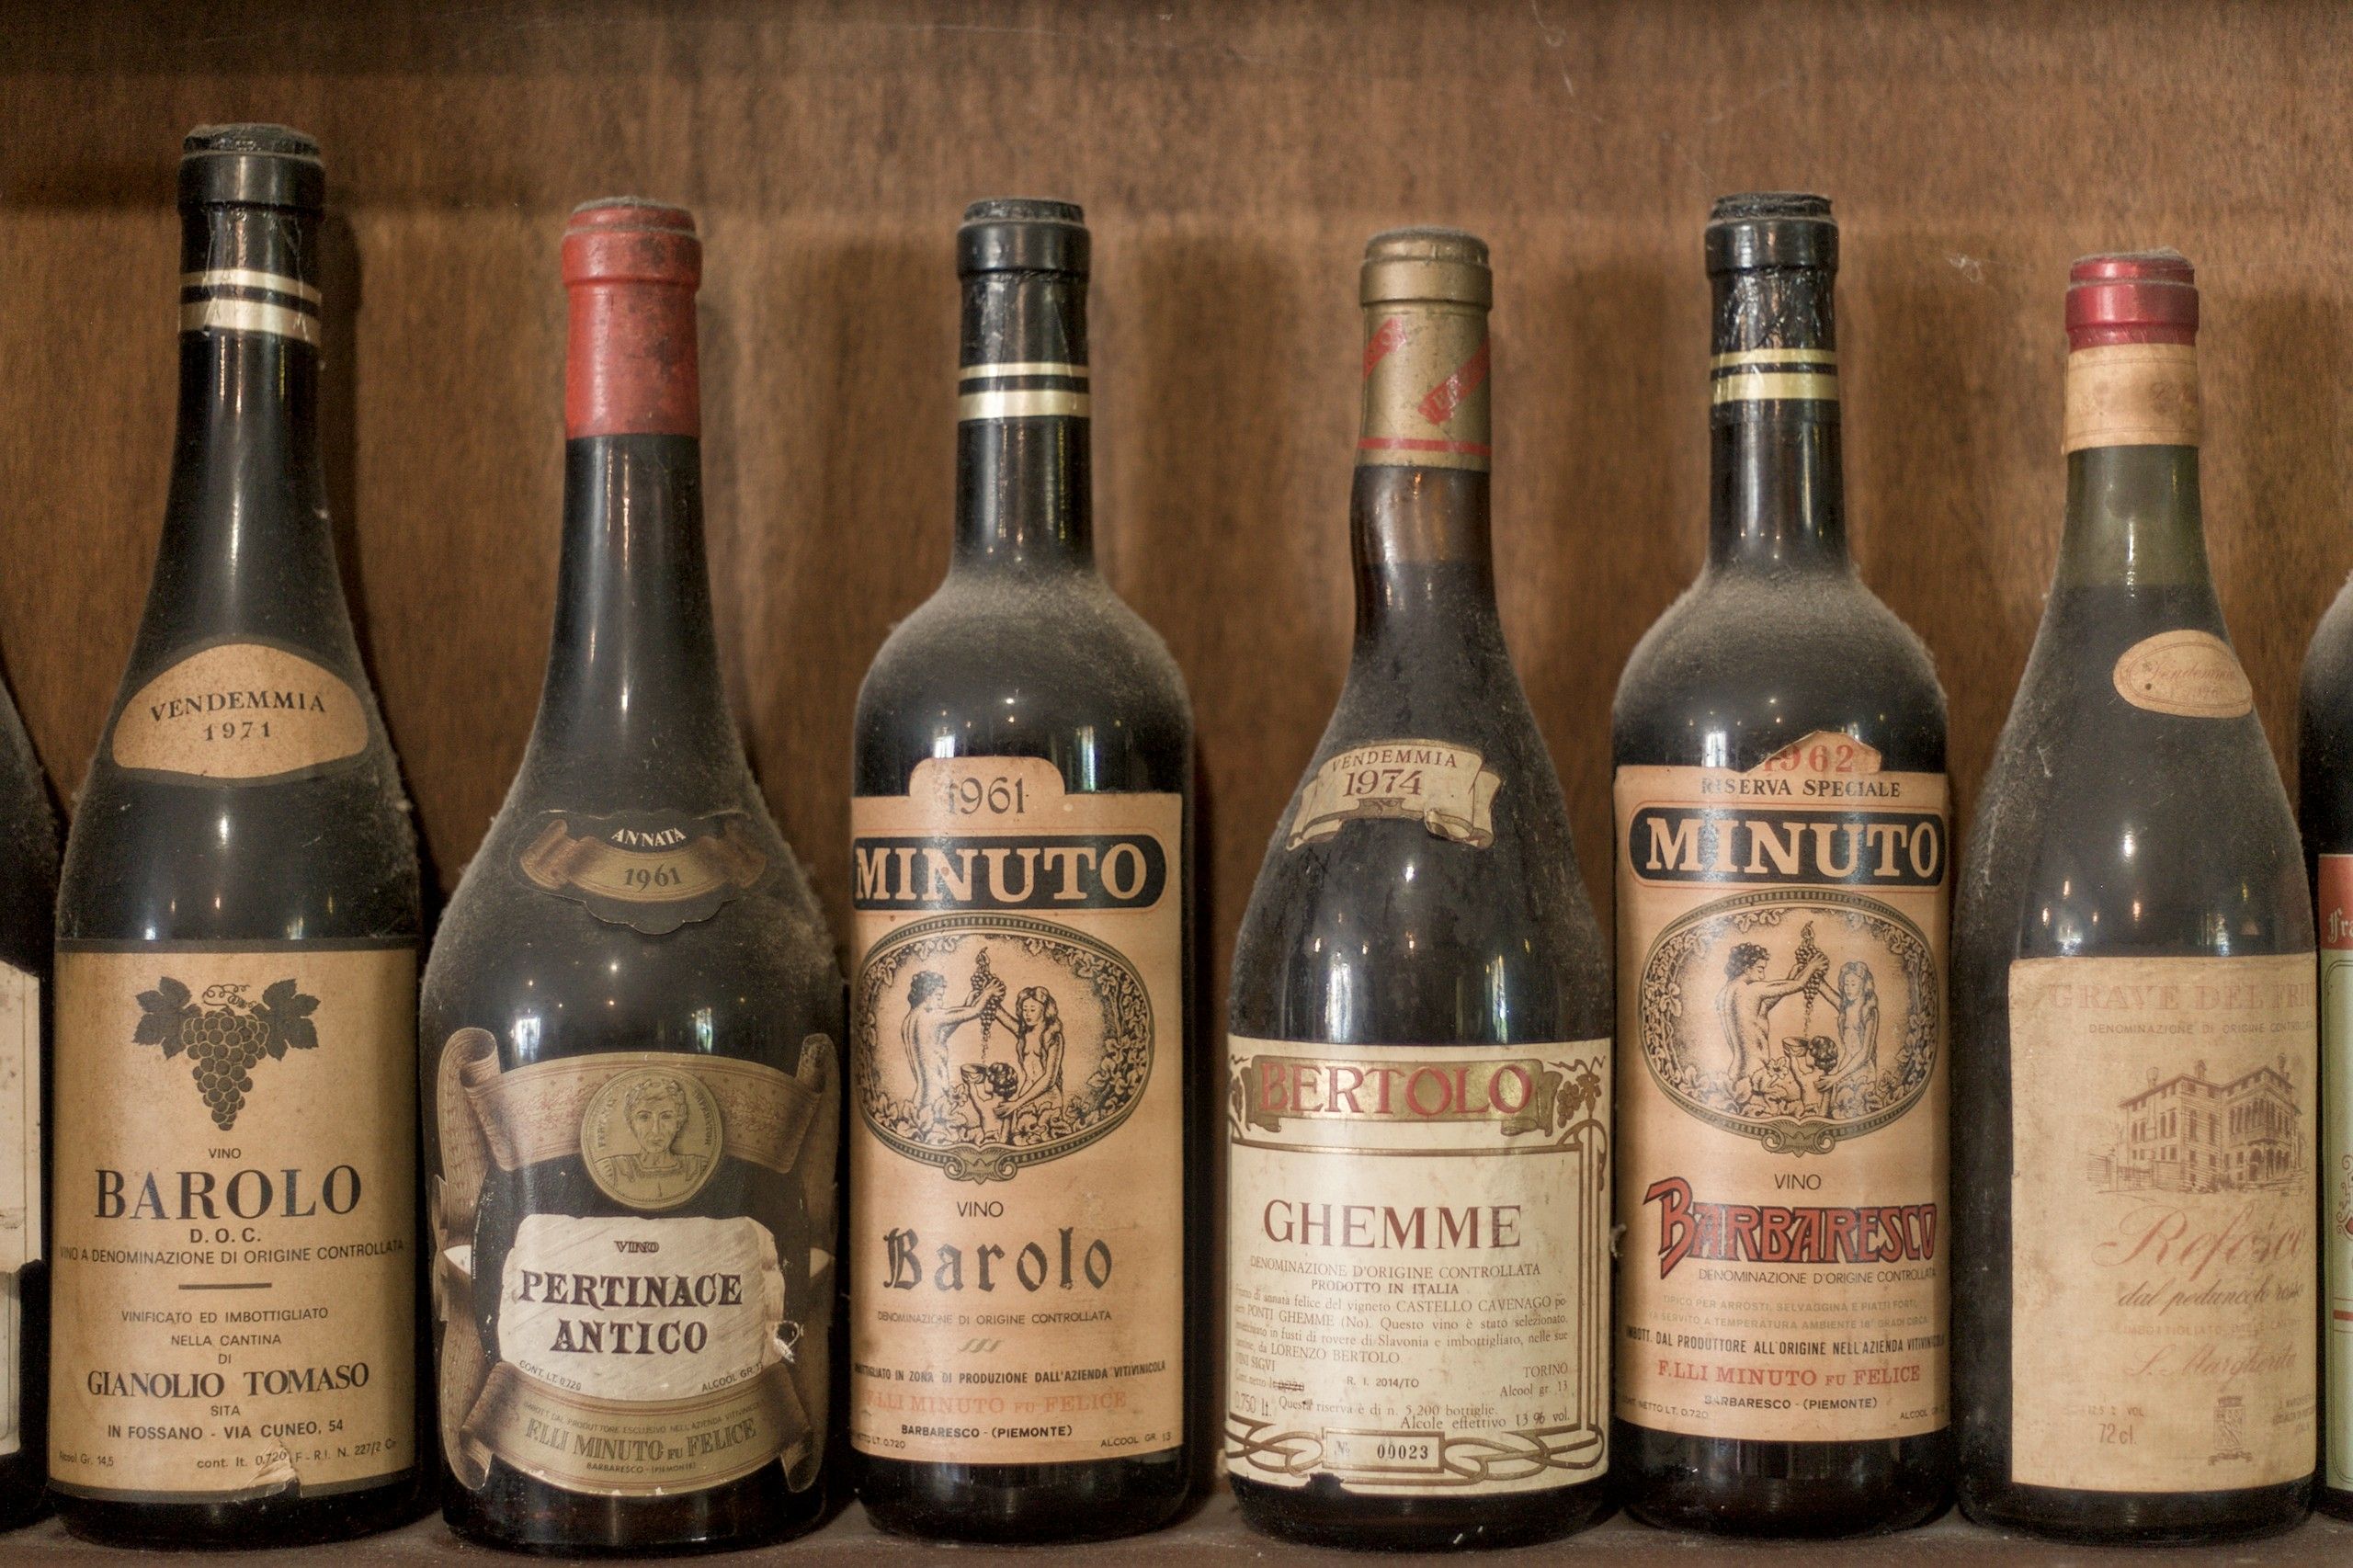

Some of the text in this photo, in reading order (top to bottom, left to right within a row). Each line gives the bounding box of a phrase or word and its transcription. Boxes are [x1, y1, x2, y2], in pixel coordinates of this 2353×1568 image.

[150, 690, 326, 722] VENDEMMIA
[203, 722, 272, 742] 1971
[1332, 749, 1457, 772] VENDEMMIA
[1342, 769, 1423, 798] 1974
[1701, 778, 1901, 798] RISERVA SPECIALE
[947, 777, 1026, 815] 1961
[610, 827, 687, 847] ANNATA
[1646, 817, 1938, 878] MINUTO
[624, 864, 682, 892] 1961
[855, 842, 1147, 903] MINUTO
[2049, 984, 2178, 1010] GRAVE
[2194, 984, 2265, 1010] DEL
[2089, 1023, 2193, 1035] DENOMINAZIONE
[2202, 1024, 2213, 1035] DI
[2222, 1021, 2266, 1035] ORIGINE
[1259, 1062, 1533, 1117] BERTOLO
[209, 1148, 242, 1159] VINO
[1774, 1174, 1822, 1190] VINO
[94, 1165, 362, 1221] BAROLO
[956, 1200, 1004, 1218] VINO
[1263, 1199, 1522, 1251] GHEMME
[1643, 1176, 1937, 1280] BARBARESCO
[59, 1239, 404, 1266] VINO A DENOMINAZIONE DI ORIGINE CONTROLLATA
[614, 1241, 659, 1253] VINO
[883, 1226, 1112, 1292] Barolo
[1250, 1256, 1540, 1279] DENOMINAZIONE D'ORIGINE CONTROLLATA
[1699, 1267, 1936, 1285] DENOMINAZIONE D'ORIGINE CONTROLLATA
[518, 1269, 743, 1311] PERTINACE
[1312, 1279, 1459, 1294] PRODOTTO IN ITALIA
[2119, 1278, 2176, 1307] dal
[1264, 1294, 1552, 1313] annata felice del vigneto CASTELLO CAVENAGO
[1664, 1294, 1692, 1306] TIPICO
[1696, 1298, 1716, 1309] PER
[1777, 1302, 1848, 1312] SELVAGGINA
[1861, 1301, 1891, 1312] PIATTI
[121, 1306, 329, 1325] VINIFICATO ED IMBOTTIGLIATO
[878, 1311, 1112, 1325] DENOMINAZIONE DI ORIGINE CONTROLLATA
[1248, 1305, 1273, 1321] PONTI
[1279, 1310, 1334, 1326] GHEMME
[1381, 1317, 1424, 1331] Questo
[1432, 1318, 1459, 1330] vino
[1481, 1318, 1508, 1330] stato
[1662, 1312, 1699, 1325] SERVITO
[1714, 1318, 1798, 1330] TEMPERATURA
[1802, 1320, 1857, 1329] AMBIENTE
[1878, 1317, 1904, 1328] GRADI
[171, 1334, 281, 1346] NELLA CANTINA
[550, 1318, 708, 1354] ANTICO
[1270, 1326, 1278, 1338] in
[1281, 1326, 1302, 1341] fusti
[1306, 1330, 1316, 1342] di
[1322, 1335, 1356, 1346] rovere
[1361, 1334, 1372, 1346] di
[1378, 1335, 1429, 1347] Slavonia
[1447, 1335, 1523, 1349] imbottigliato,
[1529, 1331, 1551, 1344] nelle
[1554, 1332, 1568, 1342] sue
[1656, 1332, 1673, 1346] DAL
[1677, 1335, 1746, 1353] PRODUTTORE
[218, 1354, 232, 1365] DI
[1271, 1343, 1326, 1360] LORENZO
[1333, 1350, 1404, 1364] BERTOLO.
[519, 1360, 543, 1378] CONT.
[895, 1369, 904, 1381] IN
[909, 1370, 934, 1383] ZONA
[942, 1372, 952, 1383] DI
[959, 1372, 1028, 1384] PRODUZIONE
[1114, 1360, 1166, 1378] VITIVINICOLA
[1523, 1363, 1568, 1379] TORINO
[1657, 1360, 1920, 1386] F.LLI MINUTO FU FELICE
[87, 1361, 369, 1398] GIANOLIO TOMASO
[701, 1374, 738, 1392] ALCOOL
[1376, 1378, 1419, 1389] 2014/TO
[1500, 1381, 1568, 1397] Alcool 13
[210, 1404, 241, 1417] SITA
[911, 1391, 1126, 1415] MINUTO FU FELICE
[1279, 1395, 1313, 1412] Questa
[1316, 1403, 1352, 1414] riserva
[1370, 1403, 1381, 1415] di
[1446, 1404, 1498, 1418] bottiglie.
[1705, 1395, 1878, 1411] BARBARESCO (PIEMONTE)
[1401, 1409, 1570, 1429] Alcole effettivo 13 % vol.
[1900, 1409, 1927, 1420] ALCOOL
[108, 1419, 344, 1440] IN FOSSANO VIA CUNEO, 54
[566, 1418, 666, 1435] PRODUTTORE ESCLUSIVO
[902, 1425, 1073, 1439] BARBARESCO (PIEMONTE)
[2097, 1423, 2116, 1444] 72
[574, 1435, 665, 1461] MINUTO
[666, 1449, 684, 1460] FU
[687, 1418, 757, 1458] FELICE
[1101, 1437, 1139, 1448] ALCOOL
[1377, 1445, 1429, 1460] 00023
[197, 1458, 228, 1469] cont.
[586, 1461, 644, 1474] BARBARESCO
